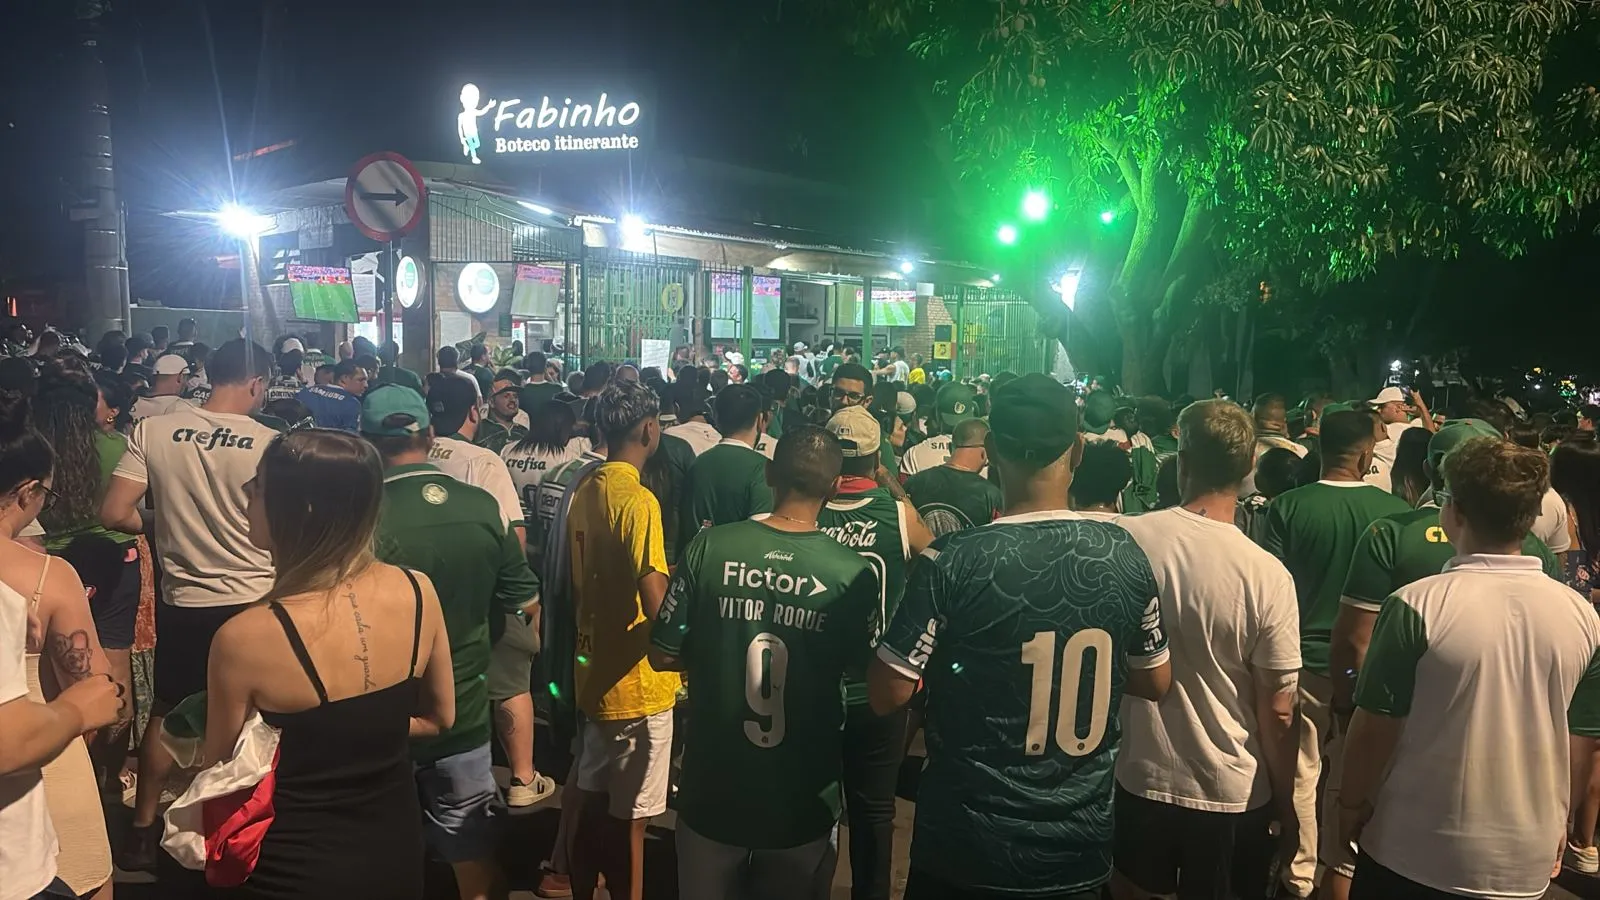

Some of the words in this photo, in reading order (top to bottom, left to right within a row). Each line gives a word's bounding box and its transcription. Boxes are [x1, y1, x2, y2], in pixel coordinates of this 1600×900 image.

[494, 92, 640, 132] Fabinho
[495, 137, 551, 153] Boteco
[554, 133, 639, 151] itinerante
[172, 427, 254, 452] crefisa
[506, 456, 546, 472] crefisa
[723, 561, 808, 597] Fictor
[718, 597, 765, 621] VITOR
[773, 602, 828, 633] ROQUE
[743, 632, 789, 748] 9
[1021, 628, 1113, 757] 10
